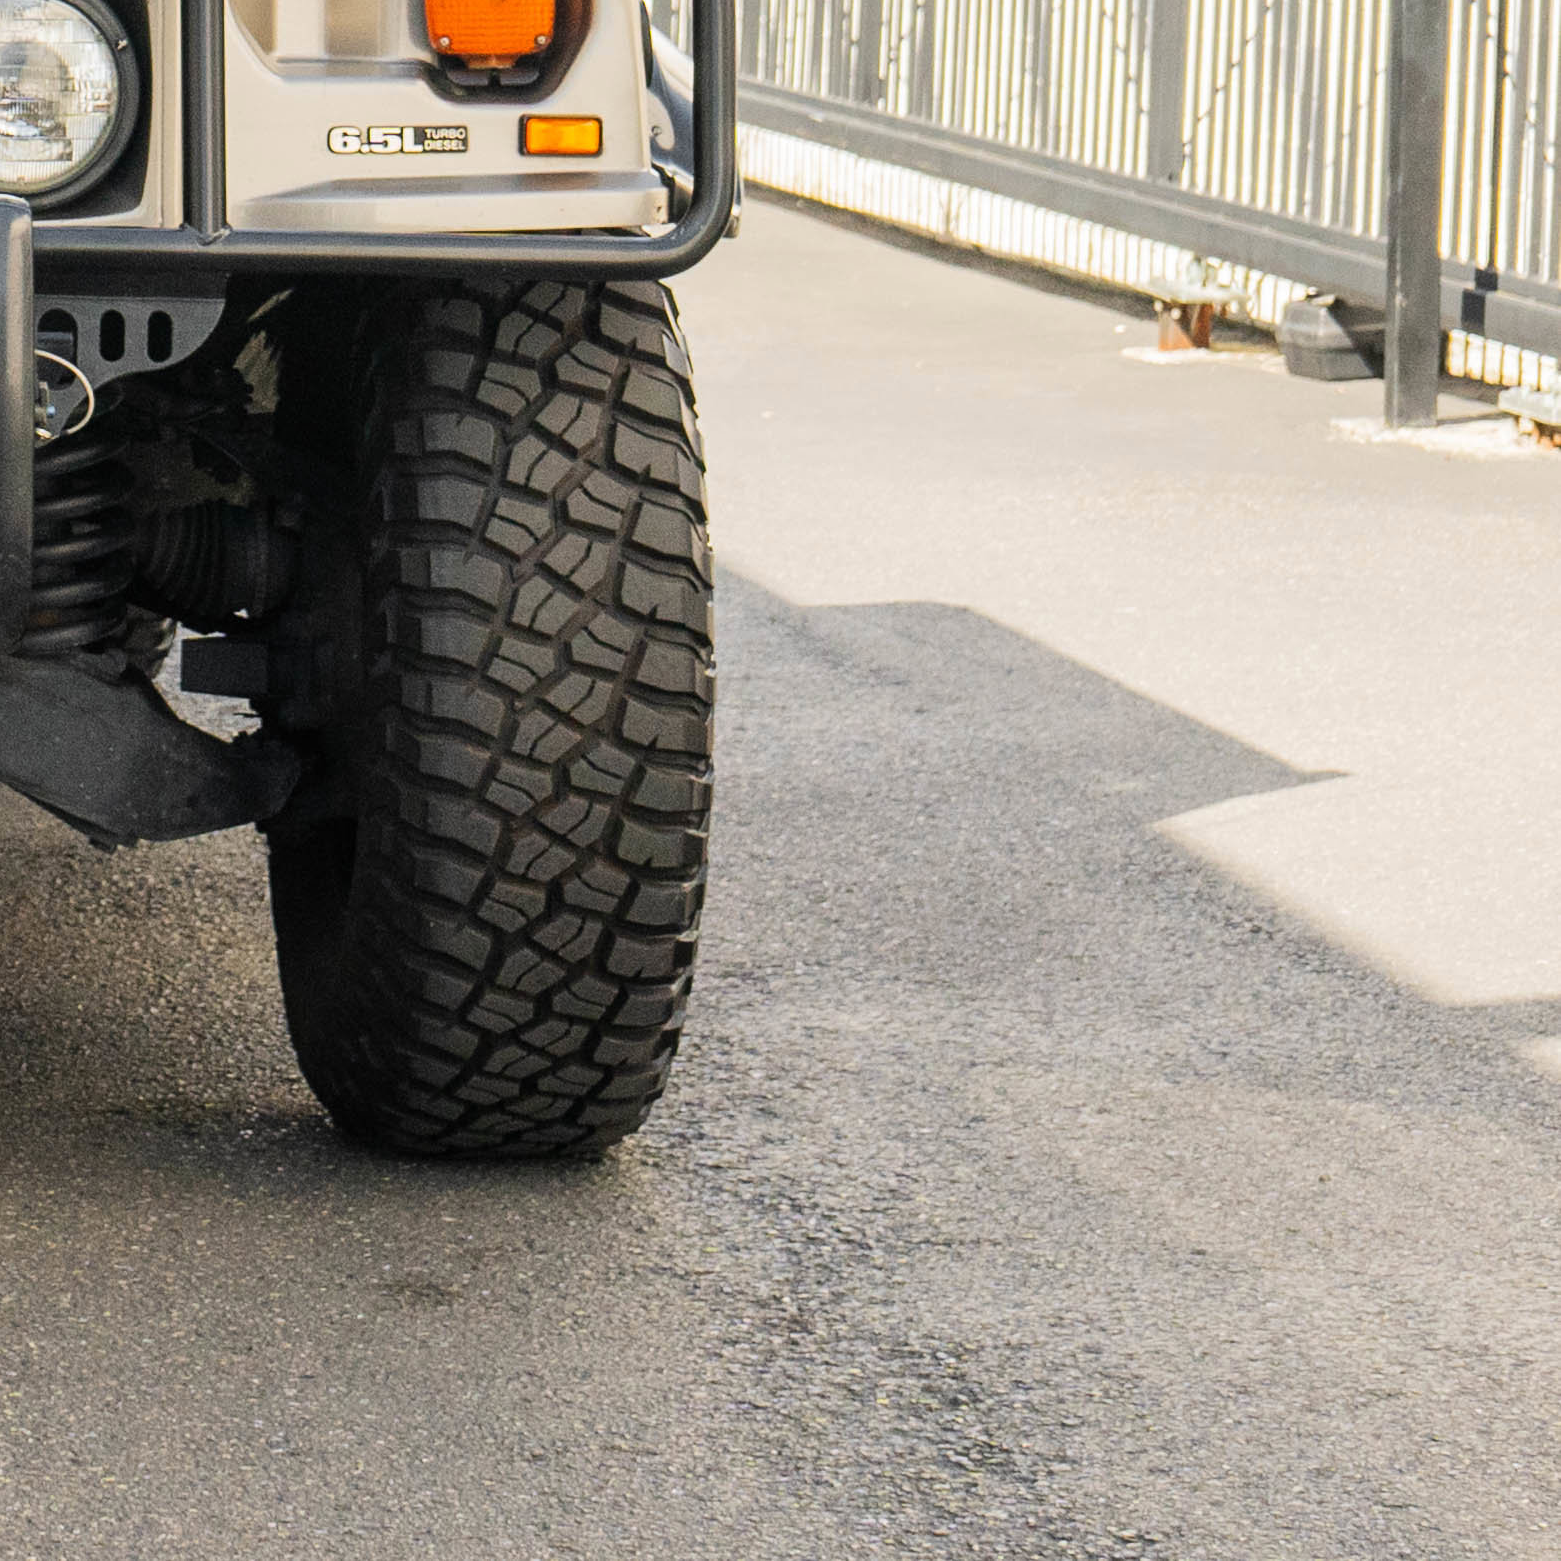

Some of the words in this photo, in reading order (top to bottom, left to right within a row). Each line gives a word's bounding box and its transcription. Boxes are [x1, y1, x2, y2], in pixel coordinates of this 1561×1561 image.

[425, 128, 466, 139] TURBO
[328, 126, 424, 154] 6.5L
[424, 140, 466, 151] DIESEL
